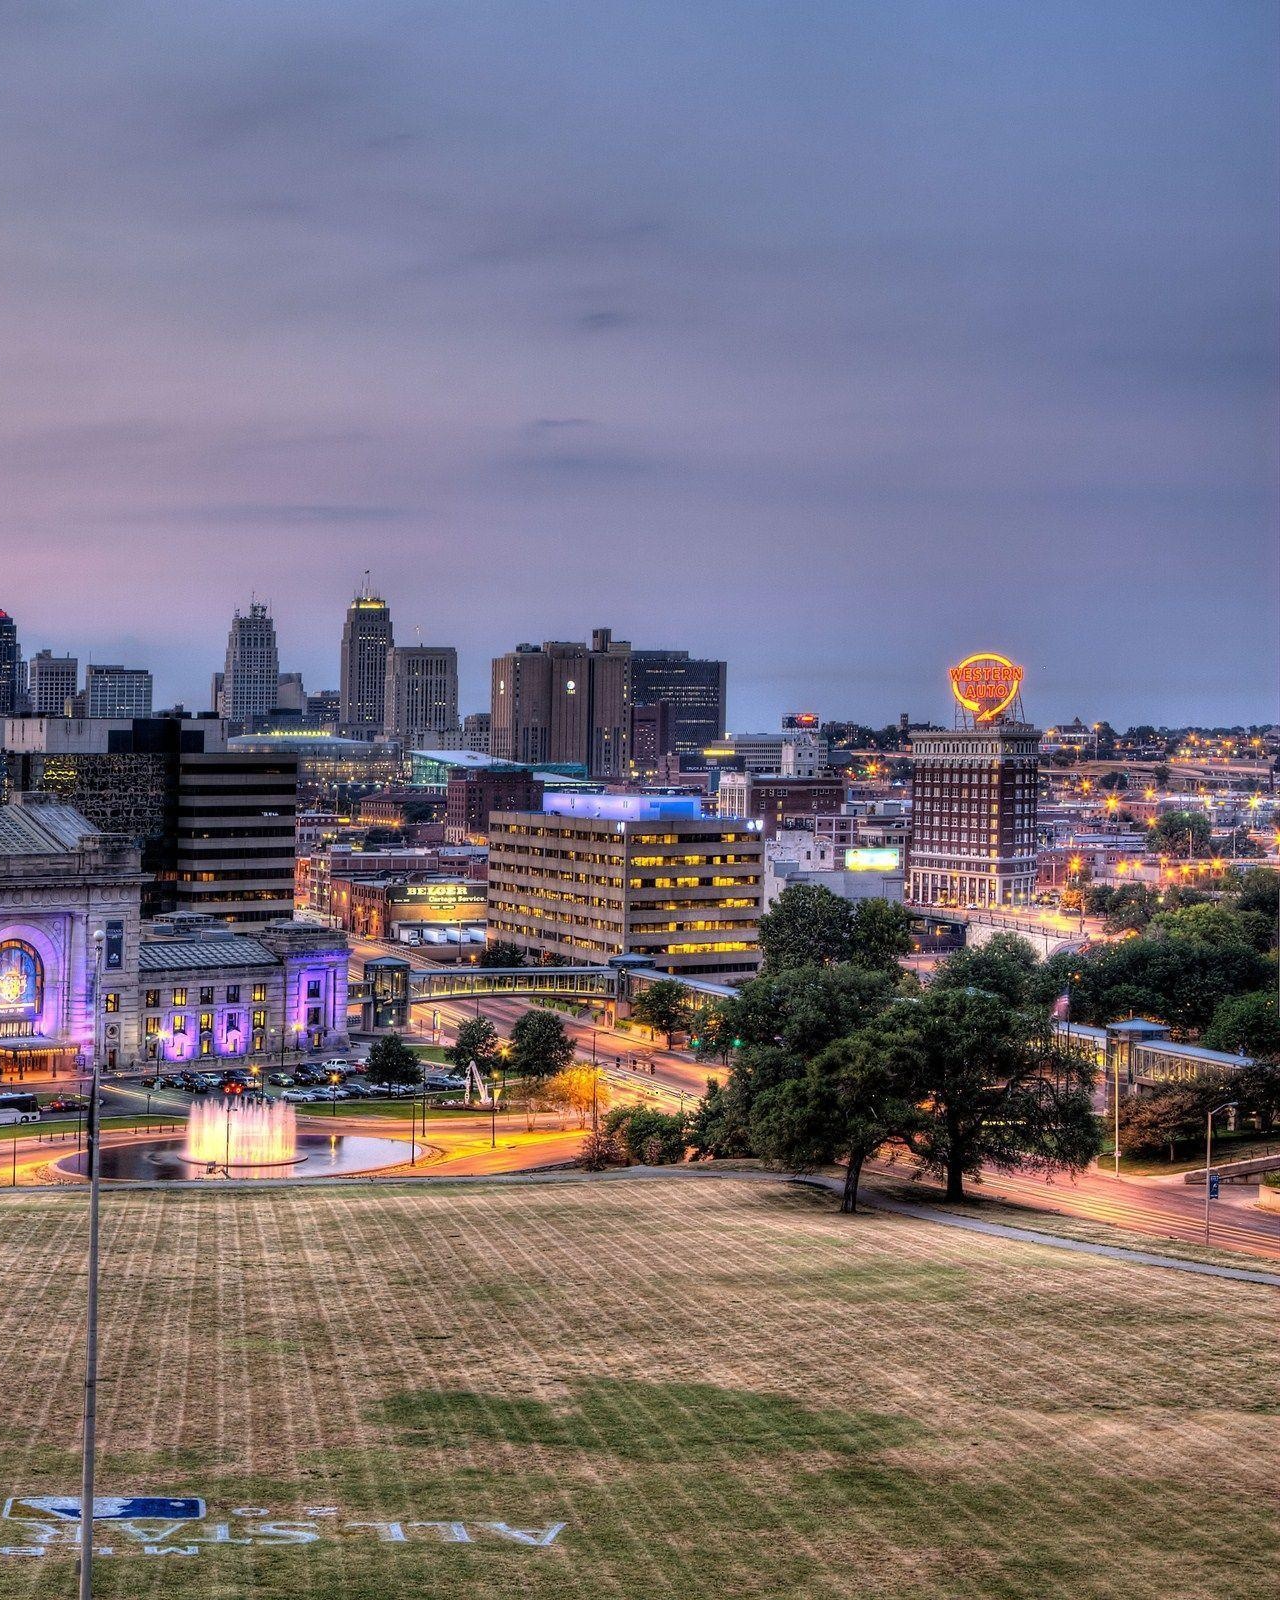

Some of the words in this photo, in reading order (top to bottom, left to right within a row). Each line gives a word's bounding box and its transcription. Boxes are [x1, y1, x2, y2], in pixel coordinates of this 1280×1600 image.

[949, 666, 1024, 681] WESTERN
[965, 684, 1008, 699] AUTO
[406, 886, 468, 896] BELGER
[20, 1519, 320, 1545] STAR
[346, 1520, 568, 1547] ALL
